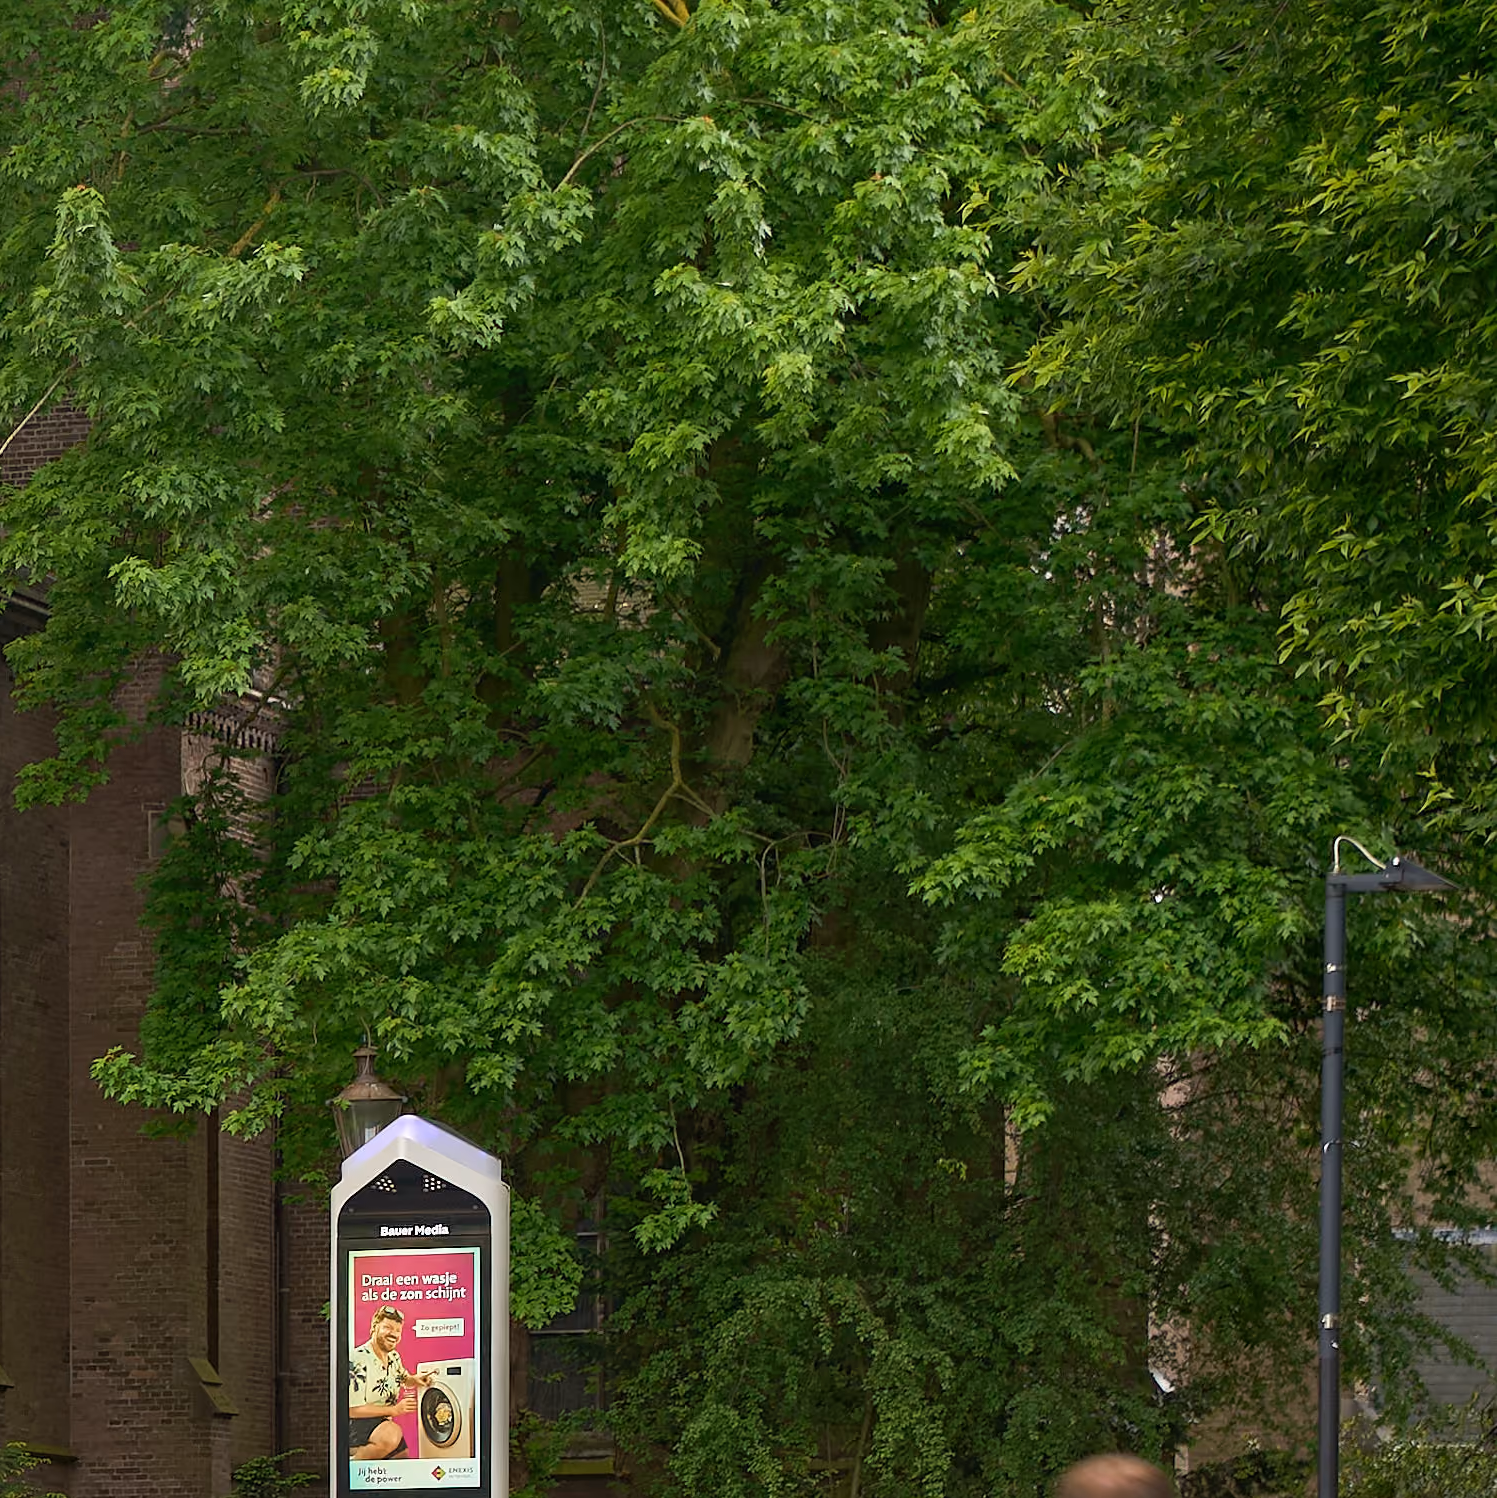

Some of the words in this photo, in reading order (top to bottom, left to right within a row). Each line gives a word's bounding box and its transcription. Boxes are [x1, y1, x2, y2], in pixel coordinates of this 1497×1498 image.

[380, 1225, 413, 1236] Bauer
[415, 1224, 449, 1235] Media
[396, 1275, 418, 1286] een
[422, 1272, 457, 1287] wasje
[361, 1288, 378, 1301] als
[381, 1288, 397, 1300] de
[400, 1290, 422, 1300] zon
[426, 1286, 466, 1301] schijnt
[368, 1466, 387, 1475] hebt
[365, 1475, 375, 1483] de
[377, 1476, 402, 1485] power
